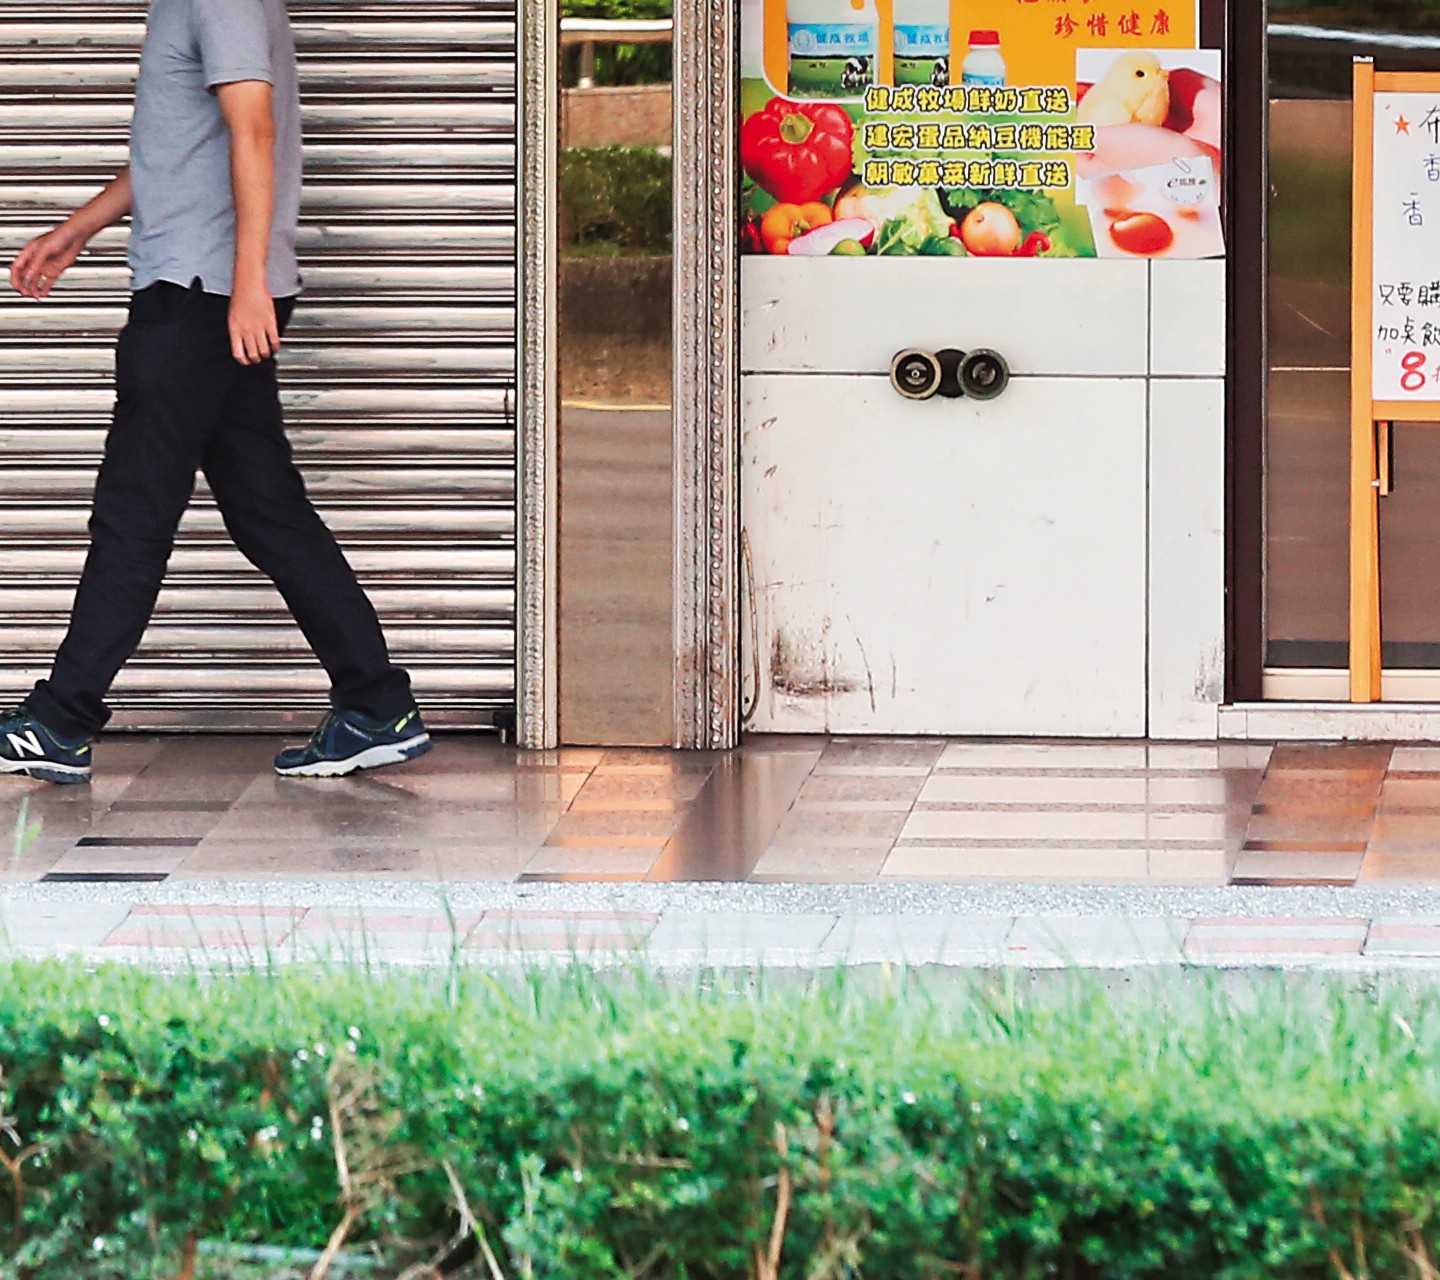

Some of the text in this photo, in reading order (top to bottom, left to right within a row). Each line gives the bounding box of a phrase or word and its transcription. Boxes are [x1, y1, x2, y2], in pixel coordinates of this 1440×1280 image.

[1054, 8, 1170, 39] 珍惜健康
[865, 87, 1070, 113] 健成牧場鮮奶直送
[865, 123, 1096, 150] 建宏蛋品納豆機能蛋
